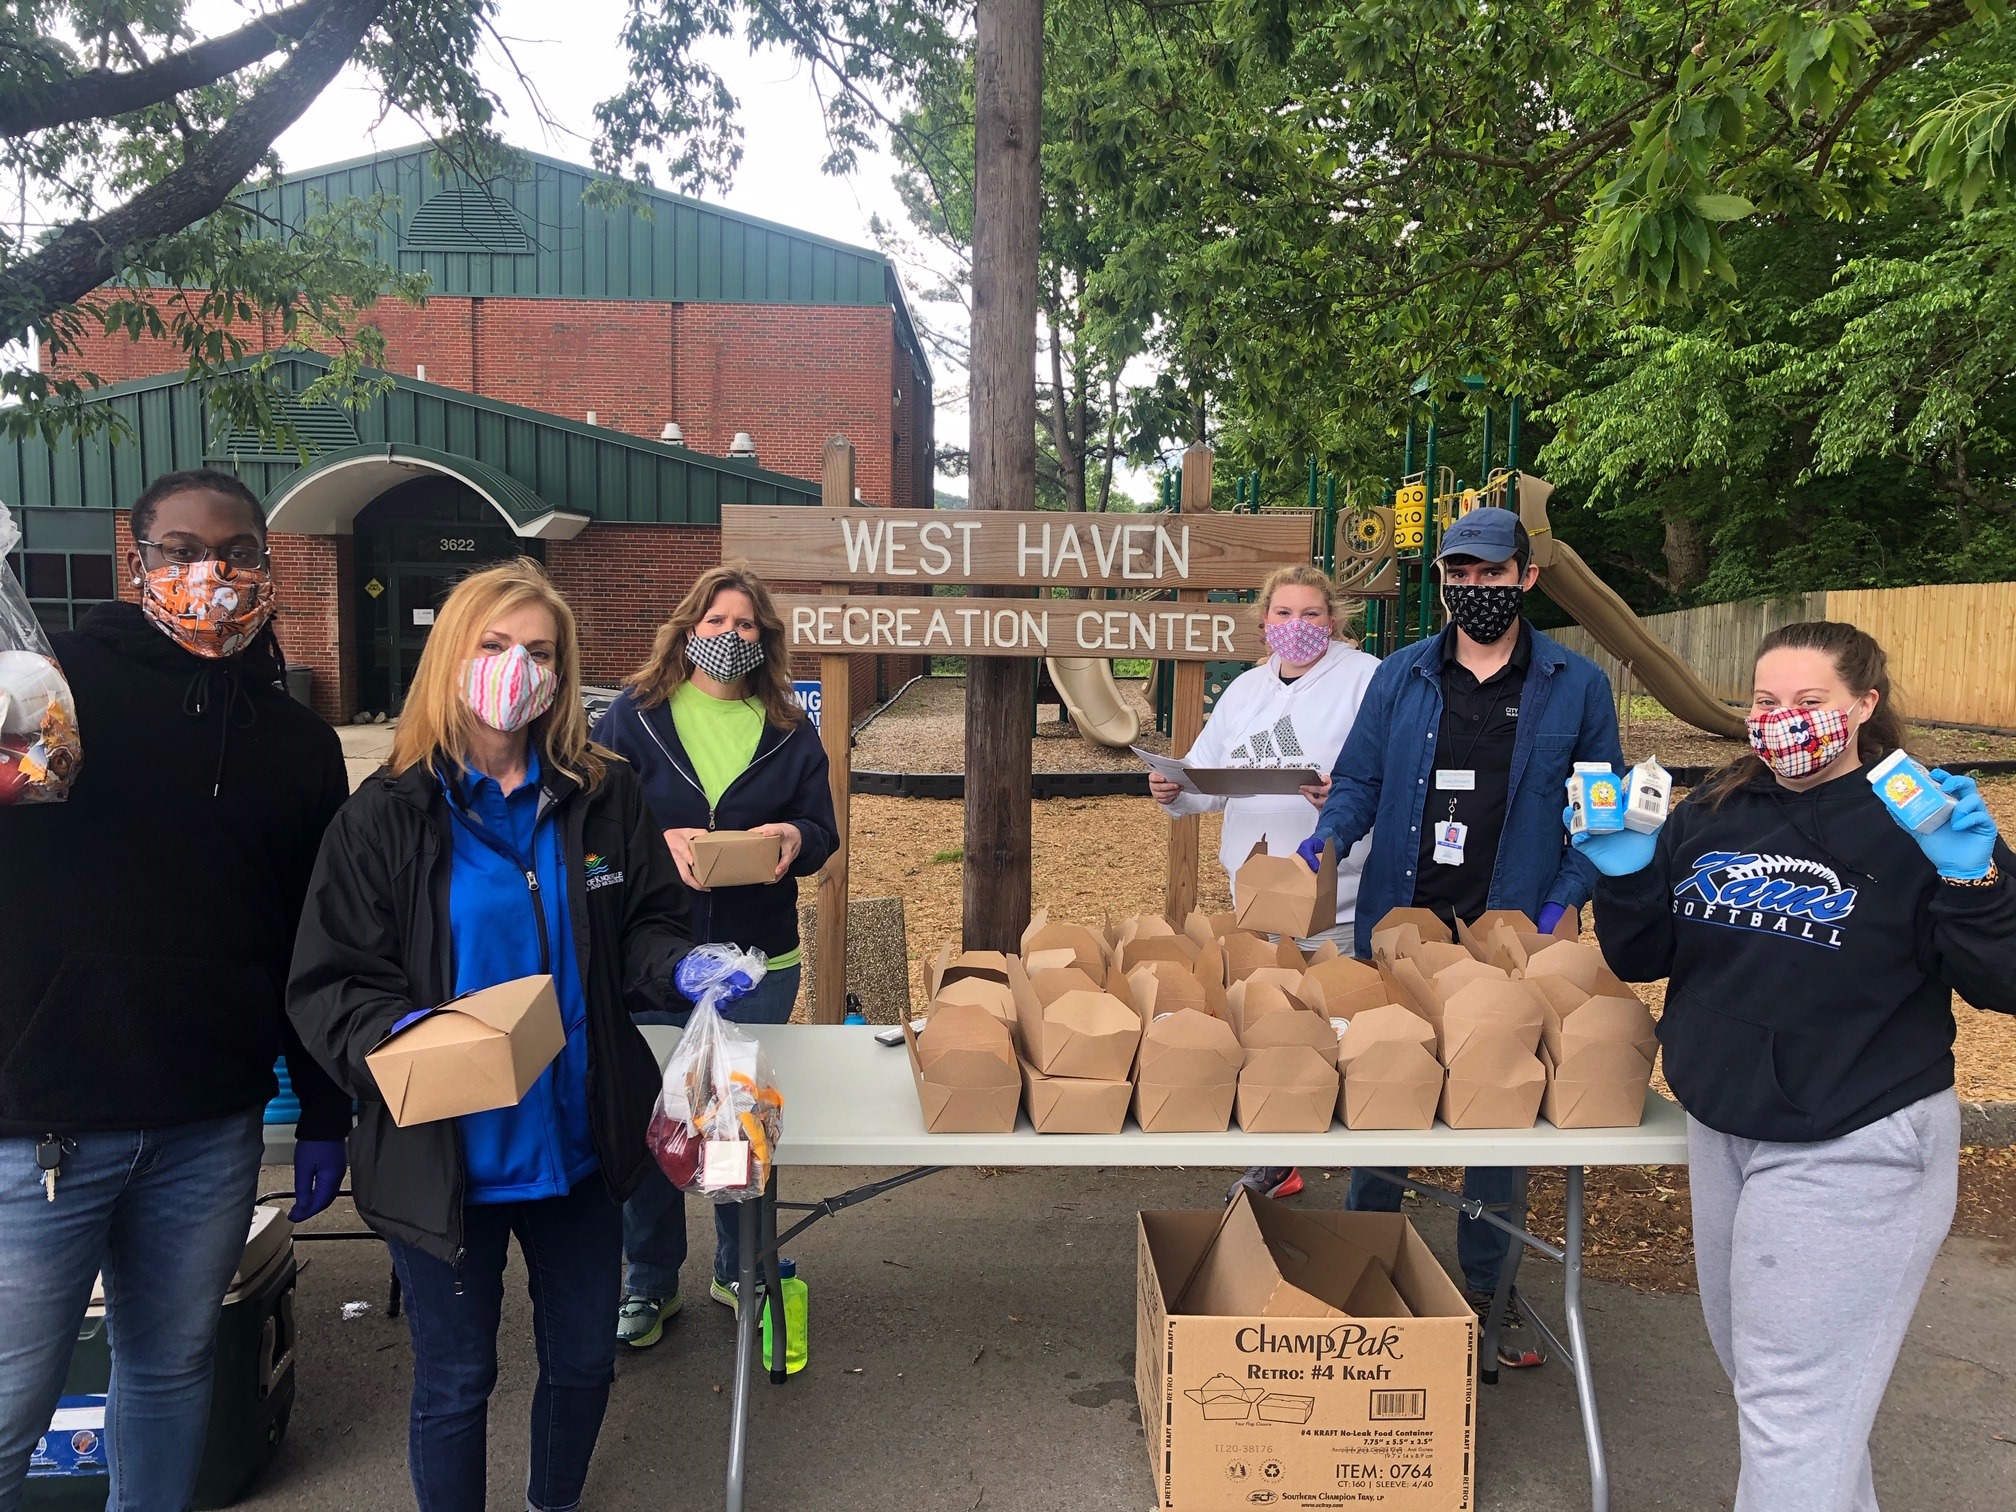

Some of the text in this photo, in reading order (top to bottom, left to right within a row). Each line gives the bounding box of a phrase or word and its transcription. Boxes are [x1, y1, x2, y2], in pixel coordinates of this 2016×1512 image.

[440, 539, 475, 551] 3622
[841, 518, 1189, 579] WEST HAVEN
[792, 606, 1236, 653] RECREATION CENTER
[794, 690, 822, 711] NG
[1505, 706, 1519, 714] CITY
[1673, 899, 1842, 947] SOFTBALL
[1247, 1364, 1391, 1380] RETRO: #4 KRAFT
[1340, 1429, 1371, 1437] No-Leak
[1374, 1429, 1393, 1437] Food
[1336, 1464, 1433, 1479] ITEM: 0764
[1376, 1480, 1409, 1488] SLEEVE:
[1412, 1480, 1433, 1489] 4/40
[1462, 1477, 1470, 1500] RETRO
